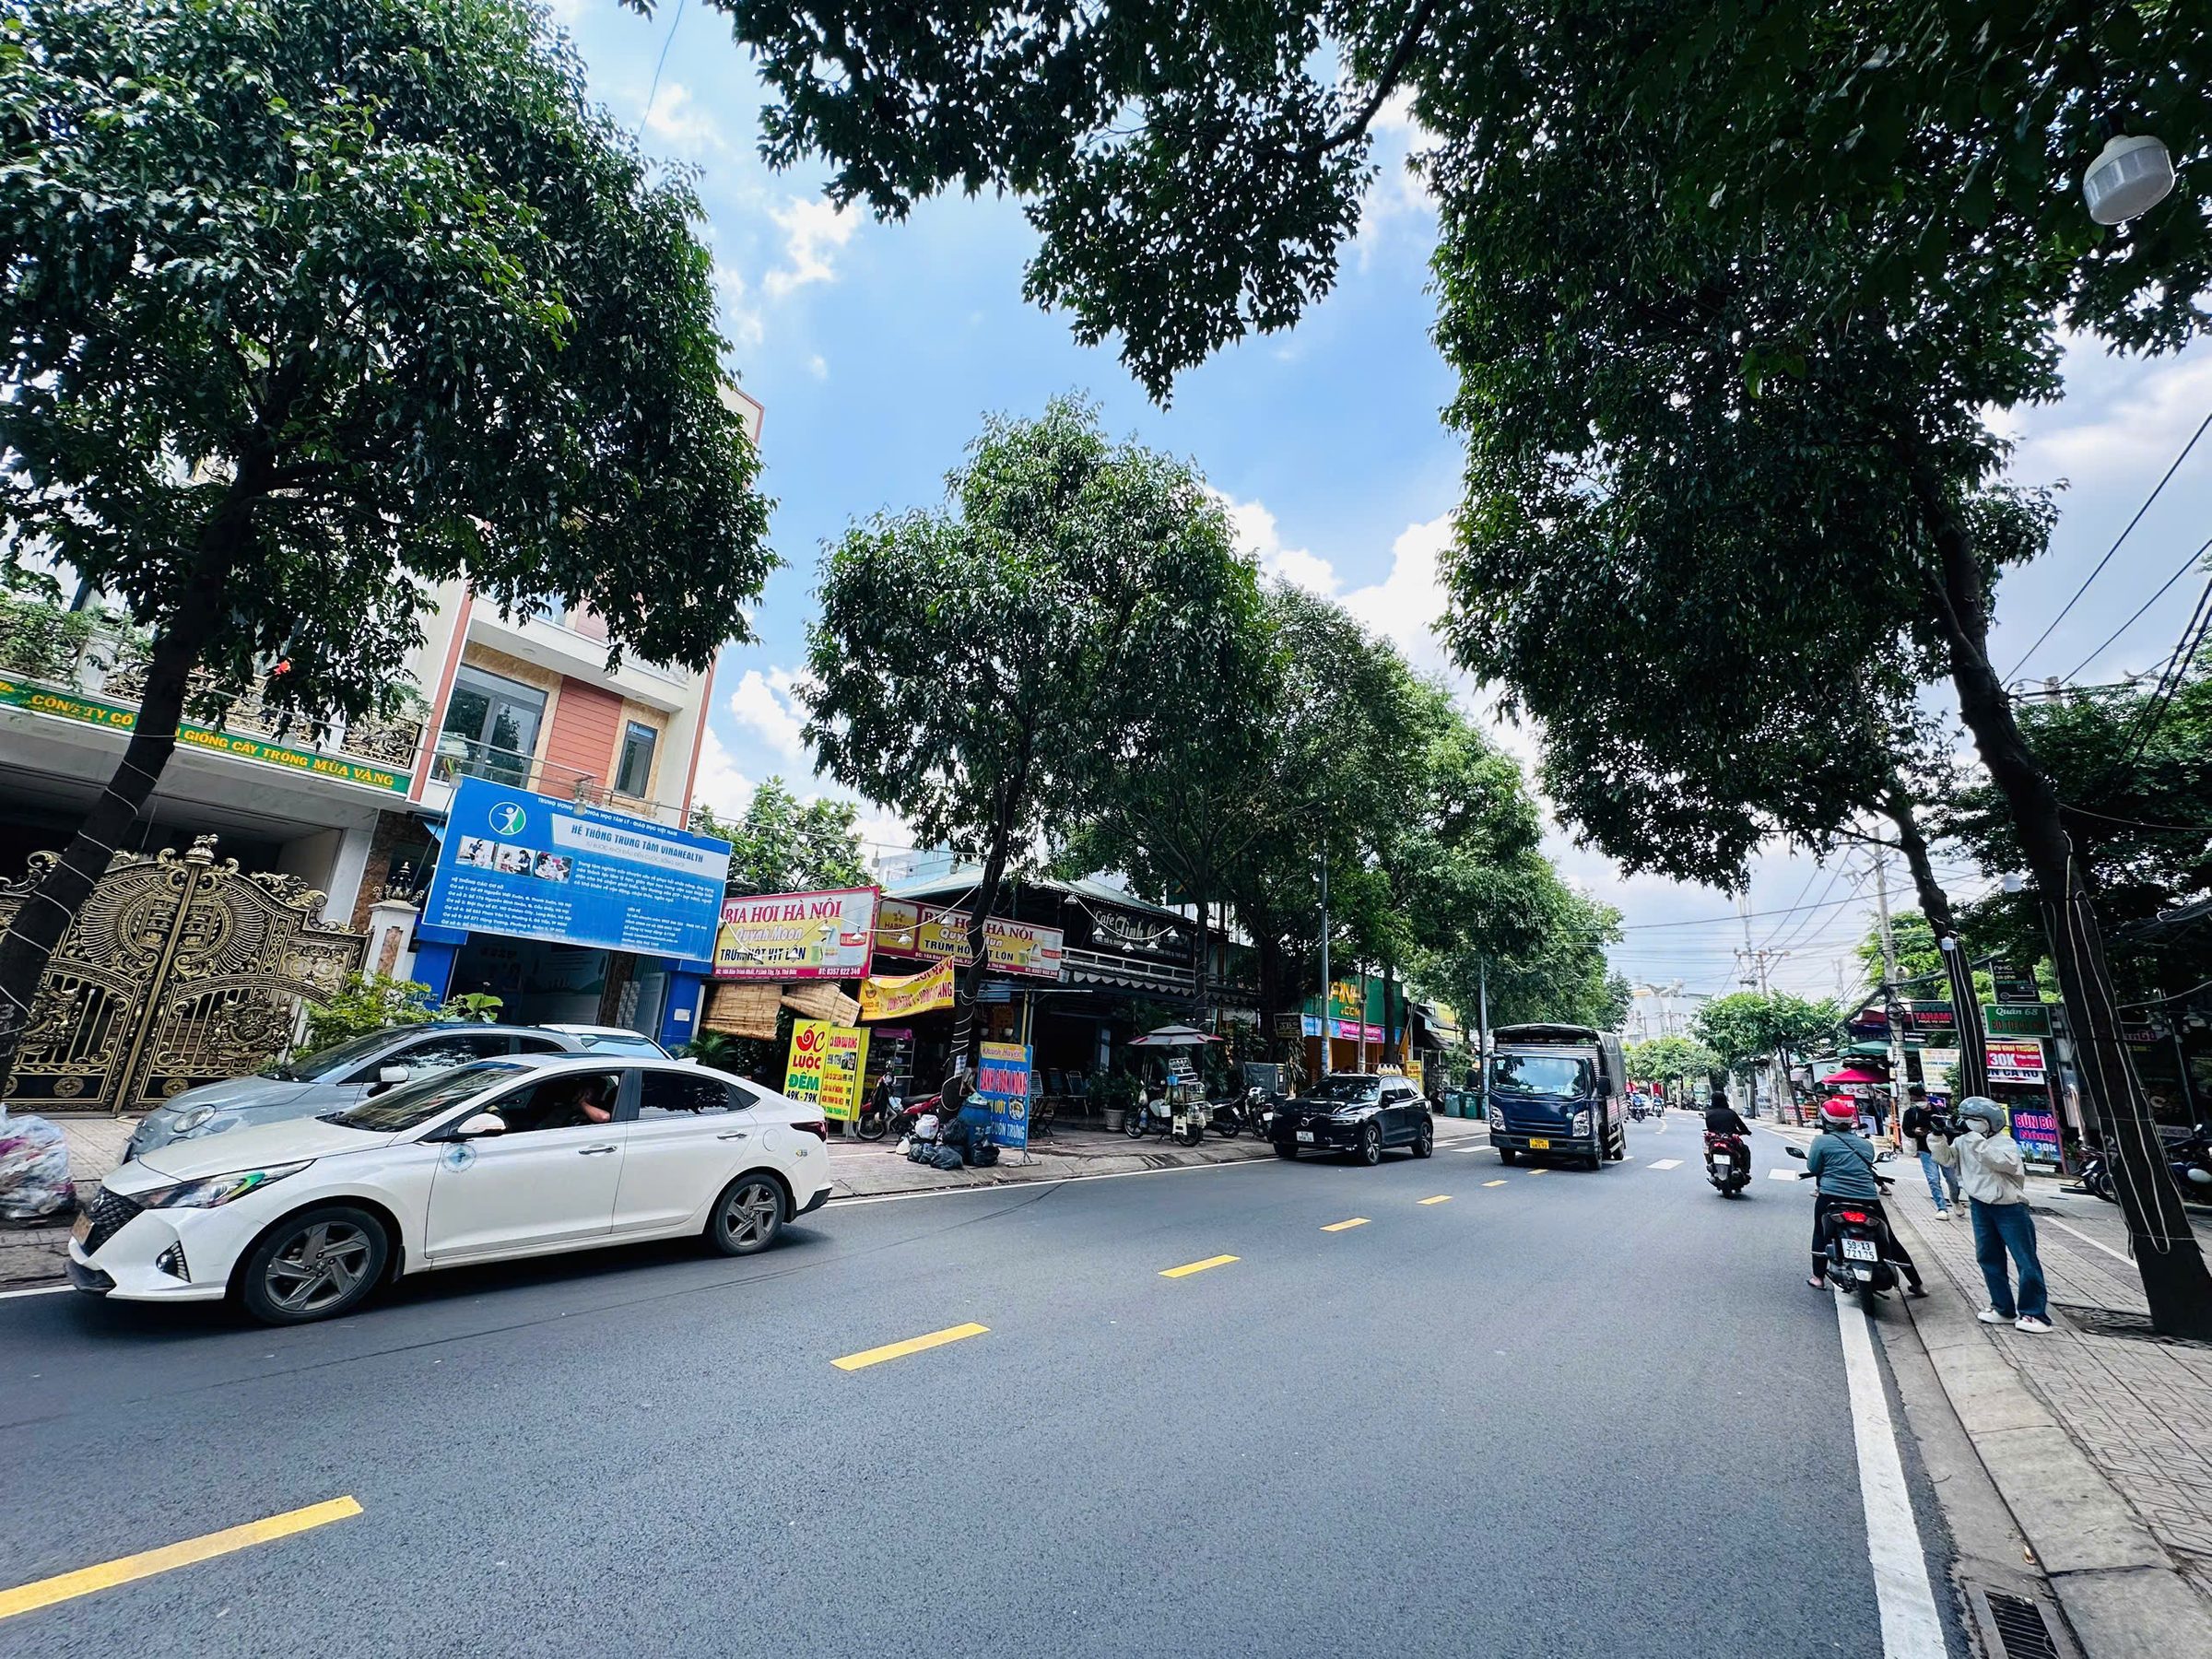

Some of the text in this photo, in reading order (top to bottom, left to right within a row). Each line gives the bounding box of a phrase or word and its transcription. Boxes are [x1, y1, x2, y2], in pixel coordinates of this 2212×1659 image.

[83, 706, 108, 720] TY
[231, 740, 258, 754] CÂY
[354, 766, 394, 787] VÀNG
[585, 827, 612, 843] THỐNG
[615, 834, 640, 849] TRUNG
[642, 840, 659, 853] TÂM
[660, 846, 704, 864] VINAHEALTH
[725, 896, 842, 924] BIA HƠI HÀ NỘI
[771, 926, 803, 942] Moon
[939, 927, 968, 943] Quỳ
[985, 923, 1006, 936] HÀ
[1009, 926, 1034, 942] NỘI
[1995, 1006, 2022, 1017] Quán
[1989, 1053, 2018, 1066] 30K
[788, 1070, 819, 1091] ĐẾM
[2015, 1112, 2055, 1130] BÚN BÒ
